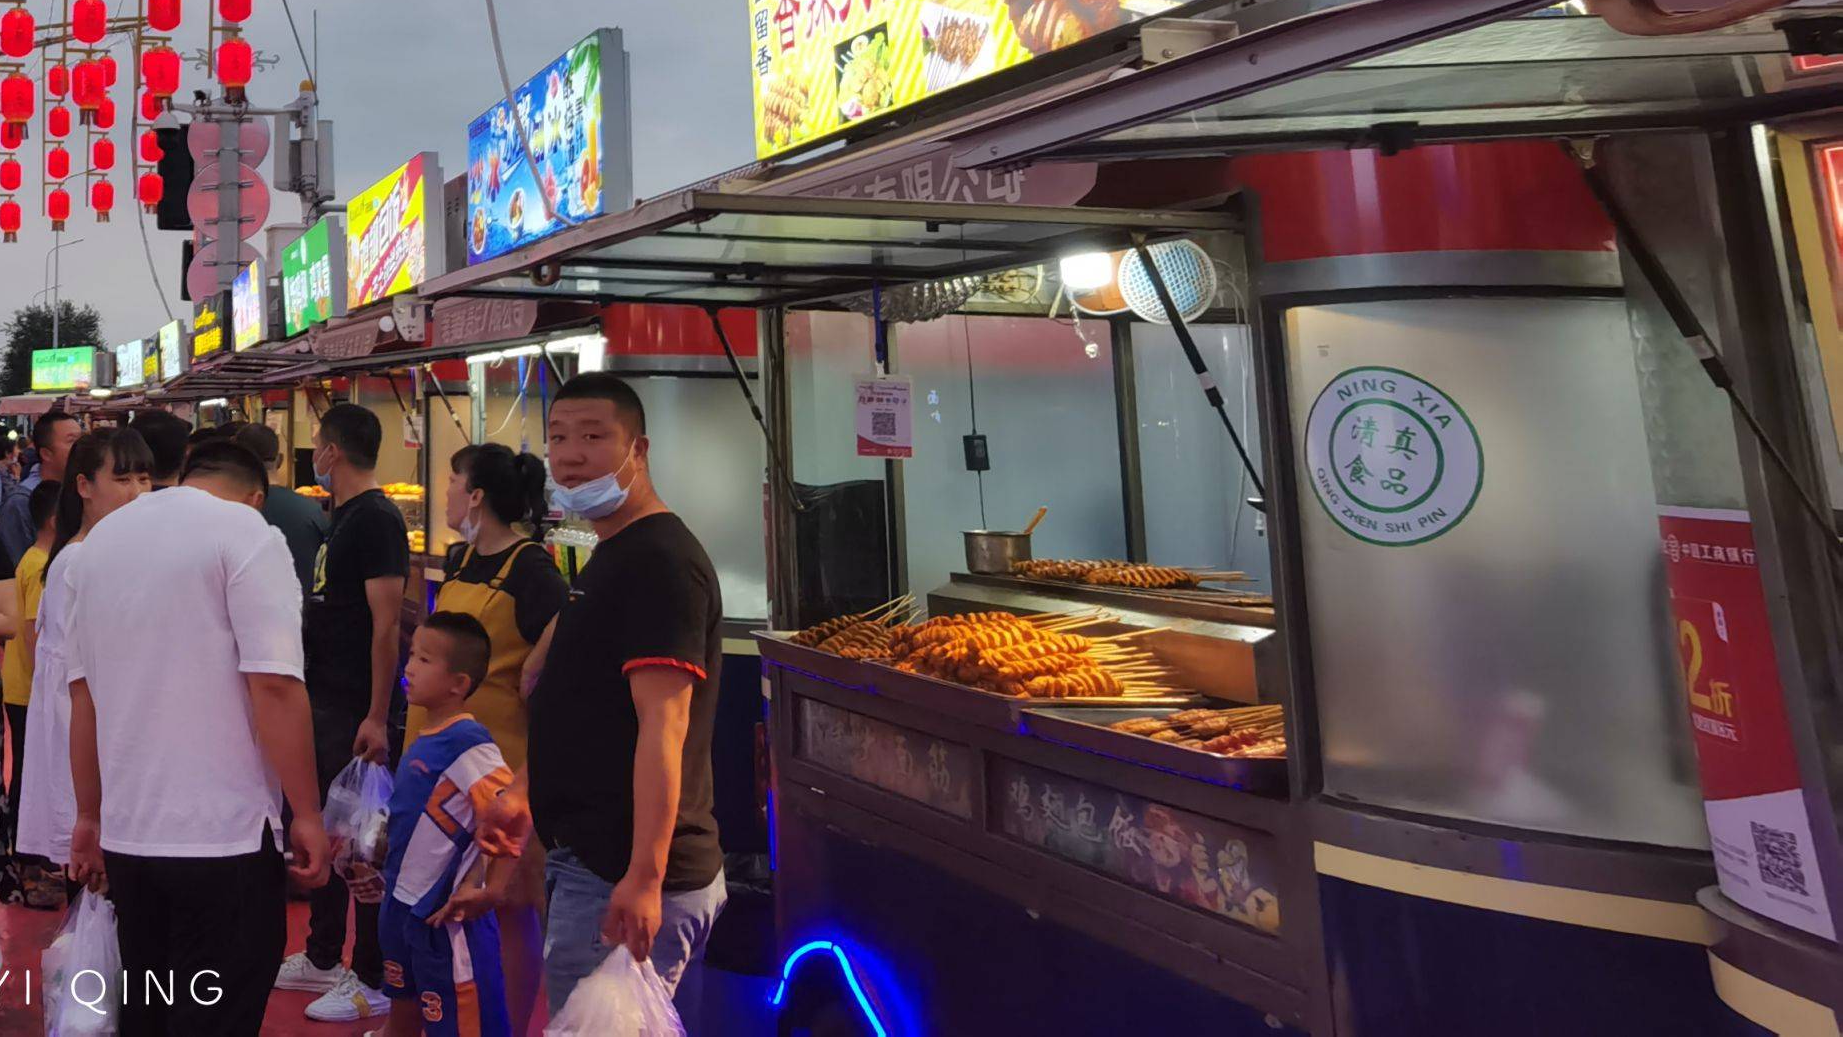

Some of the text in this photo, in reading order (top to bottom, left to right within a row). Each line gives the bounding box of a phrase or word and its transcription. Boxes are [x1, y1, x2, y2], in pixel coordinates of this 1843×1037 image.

[1336, 378, 1452, 430] NING XIA
[1351, 416, 1419, 461] 清真
[1344, 453, 1409, 496] 食品
[1316, 467, 1447, 534] QING ZHEN SHI PIN
[1681, 542, 1755, 565] 中国工商银行
